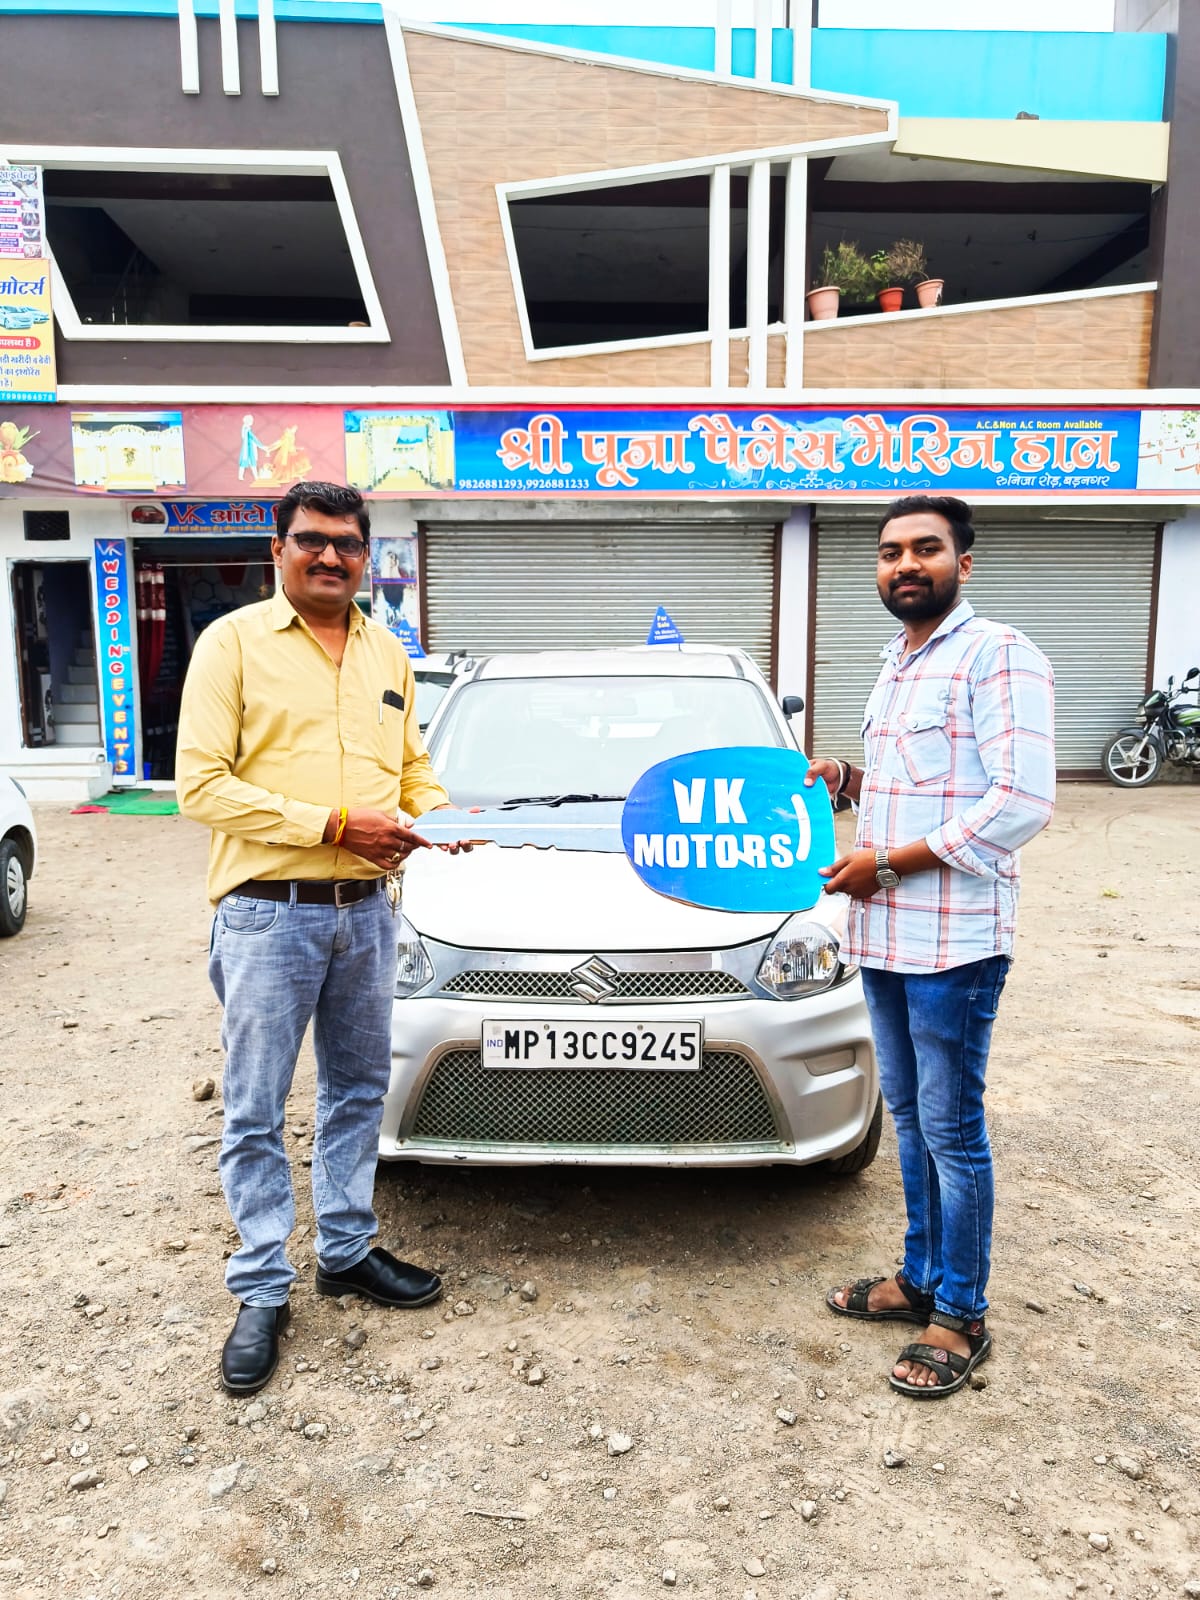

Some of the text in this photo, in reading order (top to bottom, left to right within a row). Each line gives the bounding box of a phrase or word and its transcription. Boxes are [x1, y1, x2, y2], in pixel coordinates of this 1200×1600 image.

[0, 276, 46, 295] मोटर्स
[1037, 421, 1061, 429] Room
[1064, 420, 1103, 429] Available
[496, 413, 1120, 487] श्री पूजा पैलेस मैरिज हाल
[171, 504, 207, 524] VK
[211, 503, 267, 524] ऑटो
[95, 540, 123, 556] VK
[103, 559, 125, 675] WEDDING
[111, 677, 129, 774] EVENTS
[672, 777, 748, 824] VK
[633, 833, 795, 869] MOTORS
[486, 1029, 697, 1062] IND MP13CC9245
